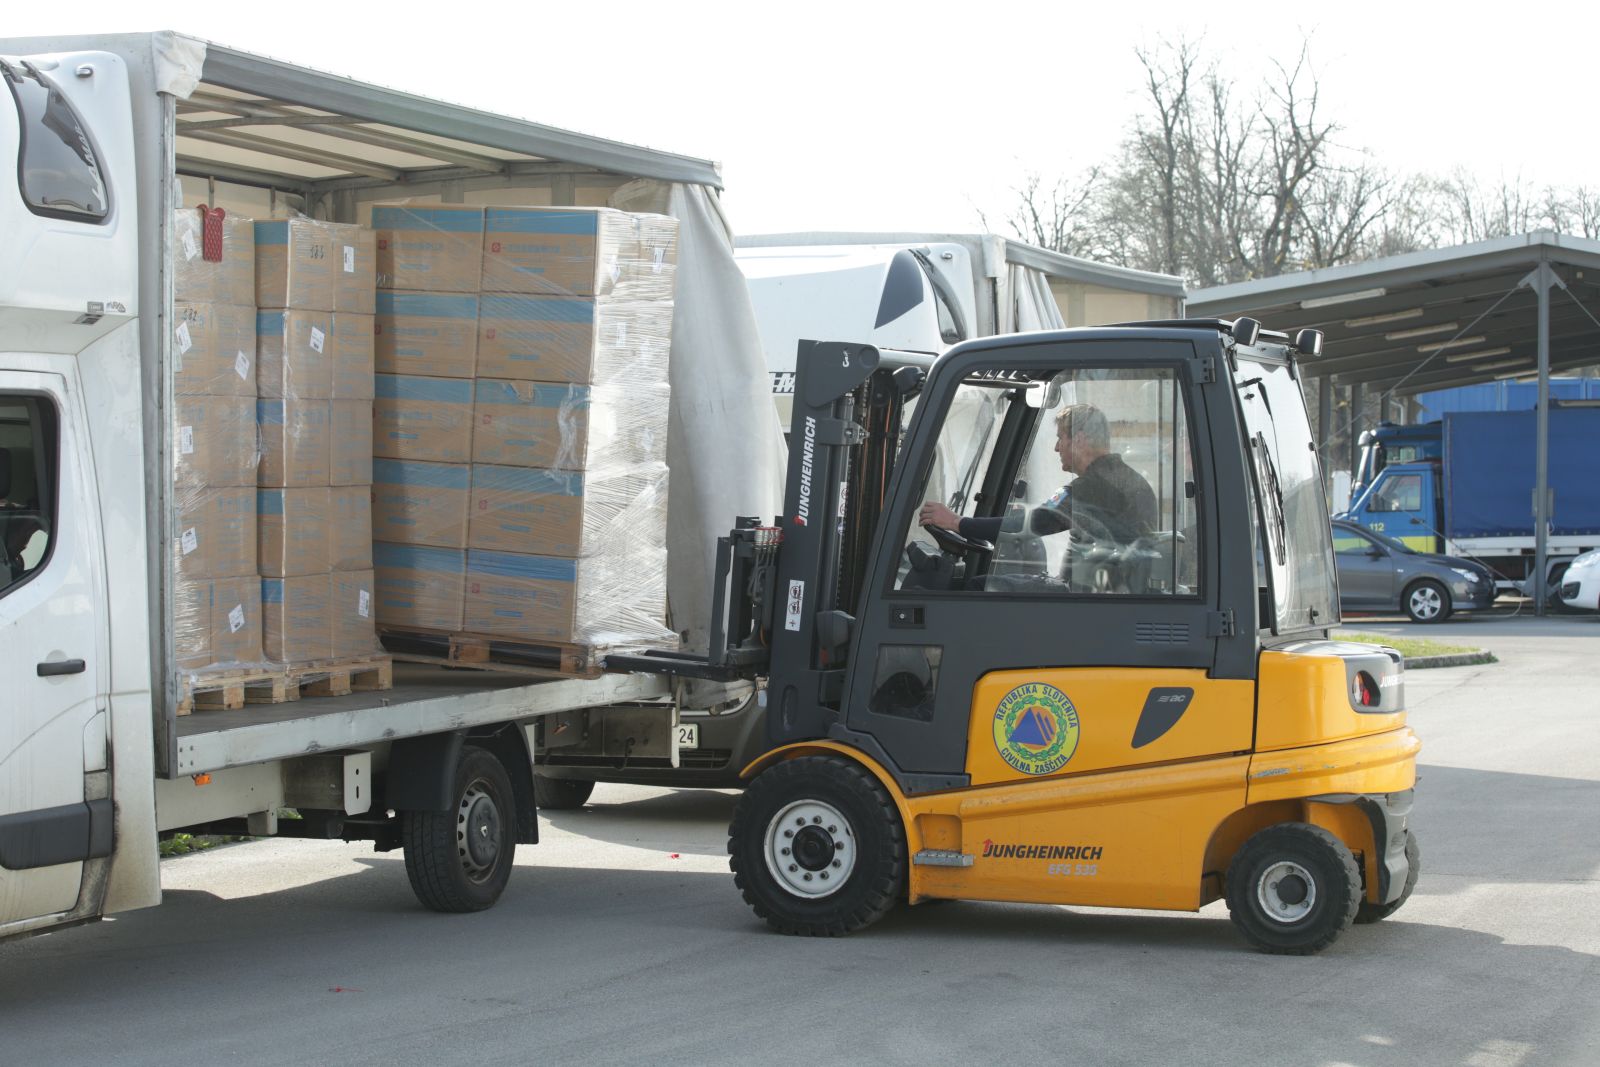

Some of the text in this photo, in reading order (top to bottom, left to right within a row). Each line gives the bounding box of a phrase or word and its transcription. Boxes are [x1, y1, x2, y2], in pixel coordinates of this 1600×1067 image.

[797, 416, 816, 527] JUNGHEINRICH
[1369, 522, 1385, 532] 112
[995, 684, 1078, 729] REPUBLIKA SLOVENIJA
[679, 728, 694, 744] 24
[1001, 747, 1068, 774] CIVILNA ZAŠČITA
[982, 842, 1104, 860] JUNGHEINRICH
